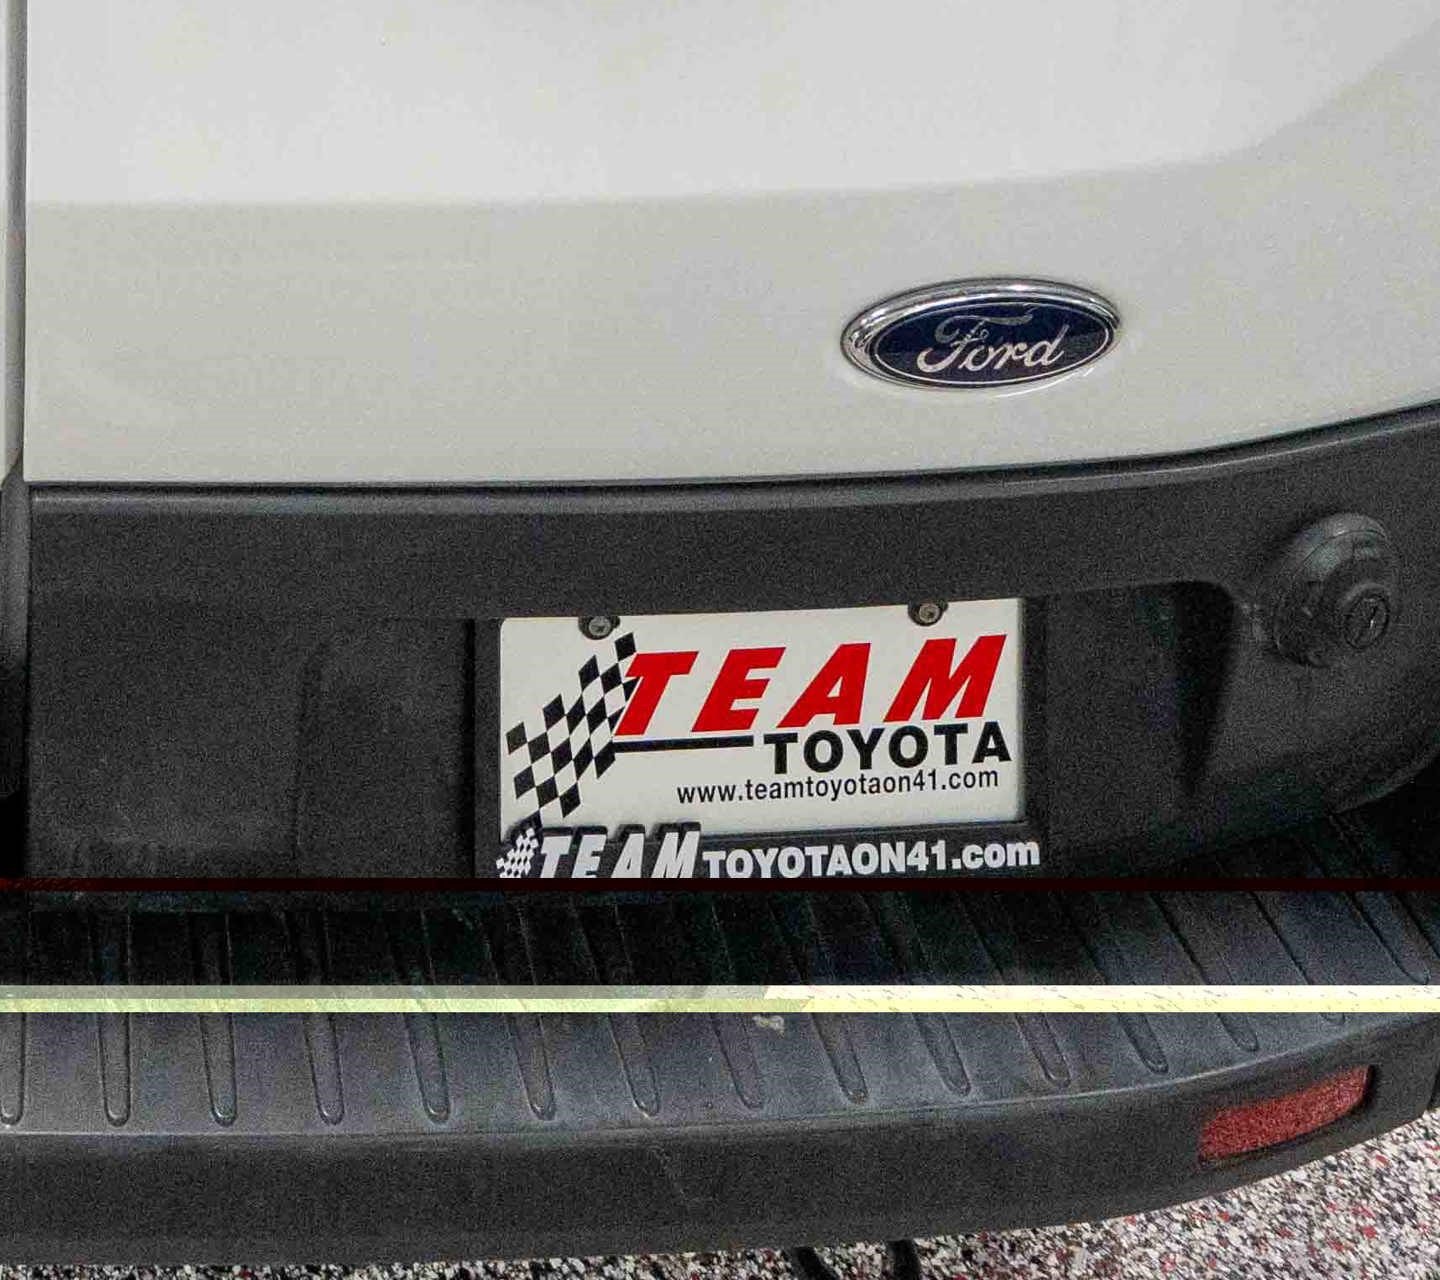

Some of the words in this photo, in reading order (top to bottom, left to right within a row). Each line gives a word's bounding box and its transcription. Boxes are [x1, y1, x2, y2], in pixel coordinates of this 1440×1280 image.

[916, 306, 1070, 373] Ford
[613, 634, 1008, 737] TEAM
[763, 720, 1012, 774] TOYOTA
[676, 768, 1000, 805] www.teamtoyotaon41.com
[537, 831, 702, 878] TEAM
[702, 838, 1041, 878] TOYOTAON41.com
